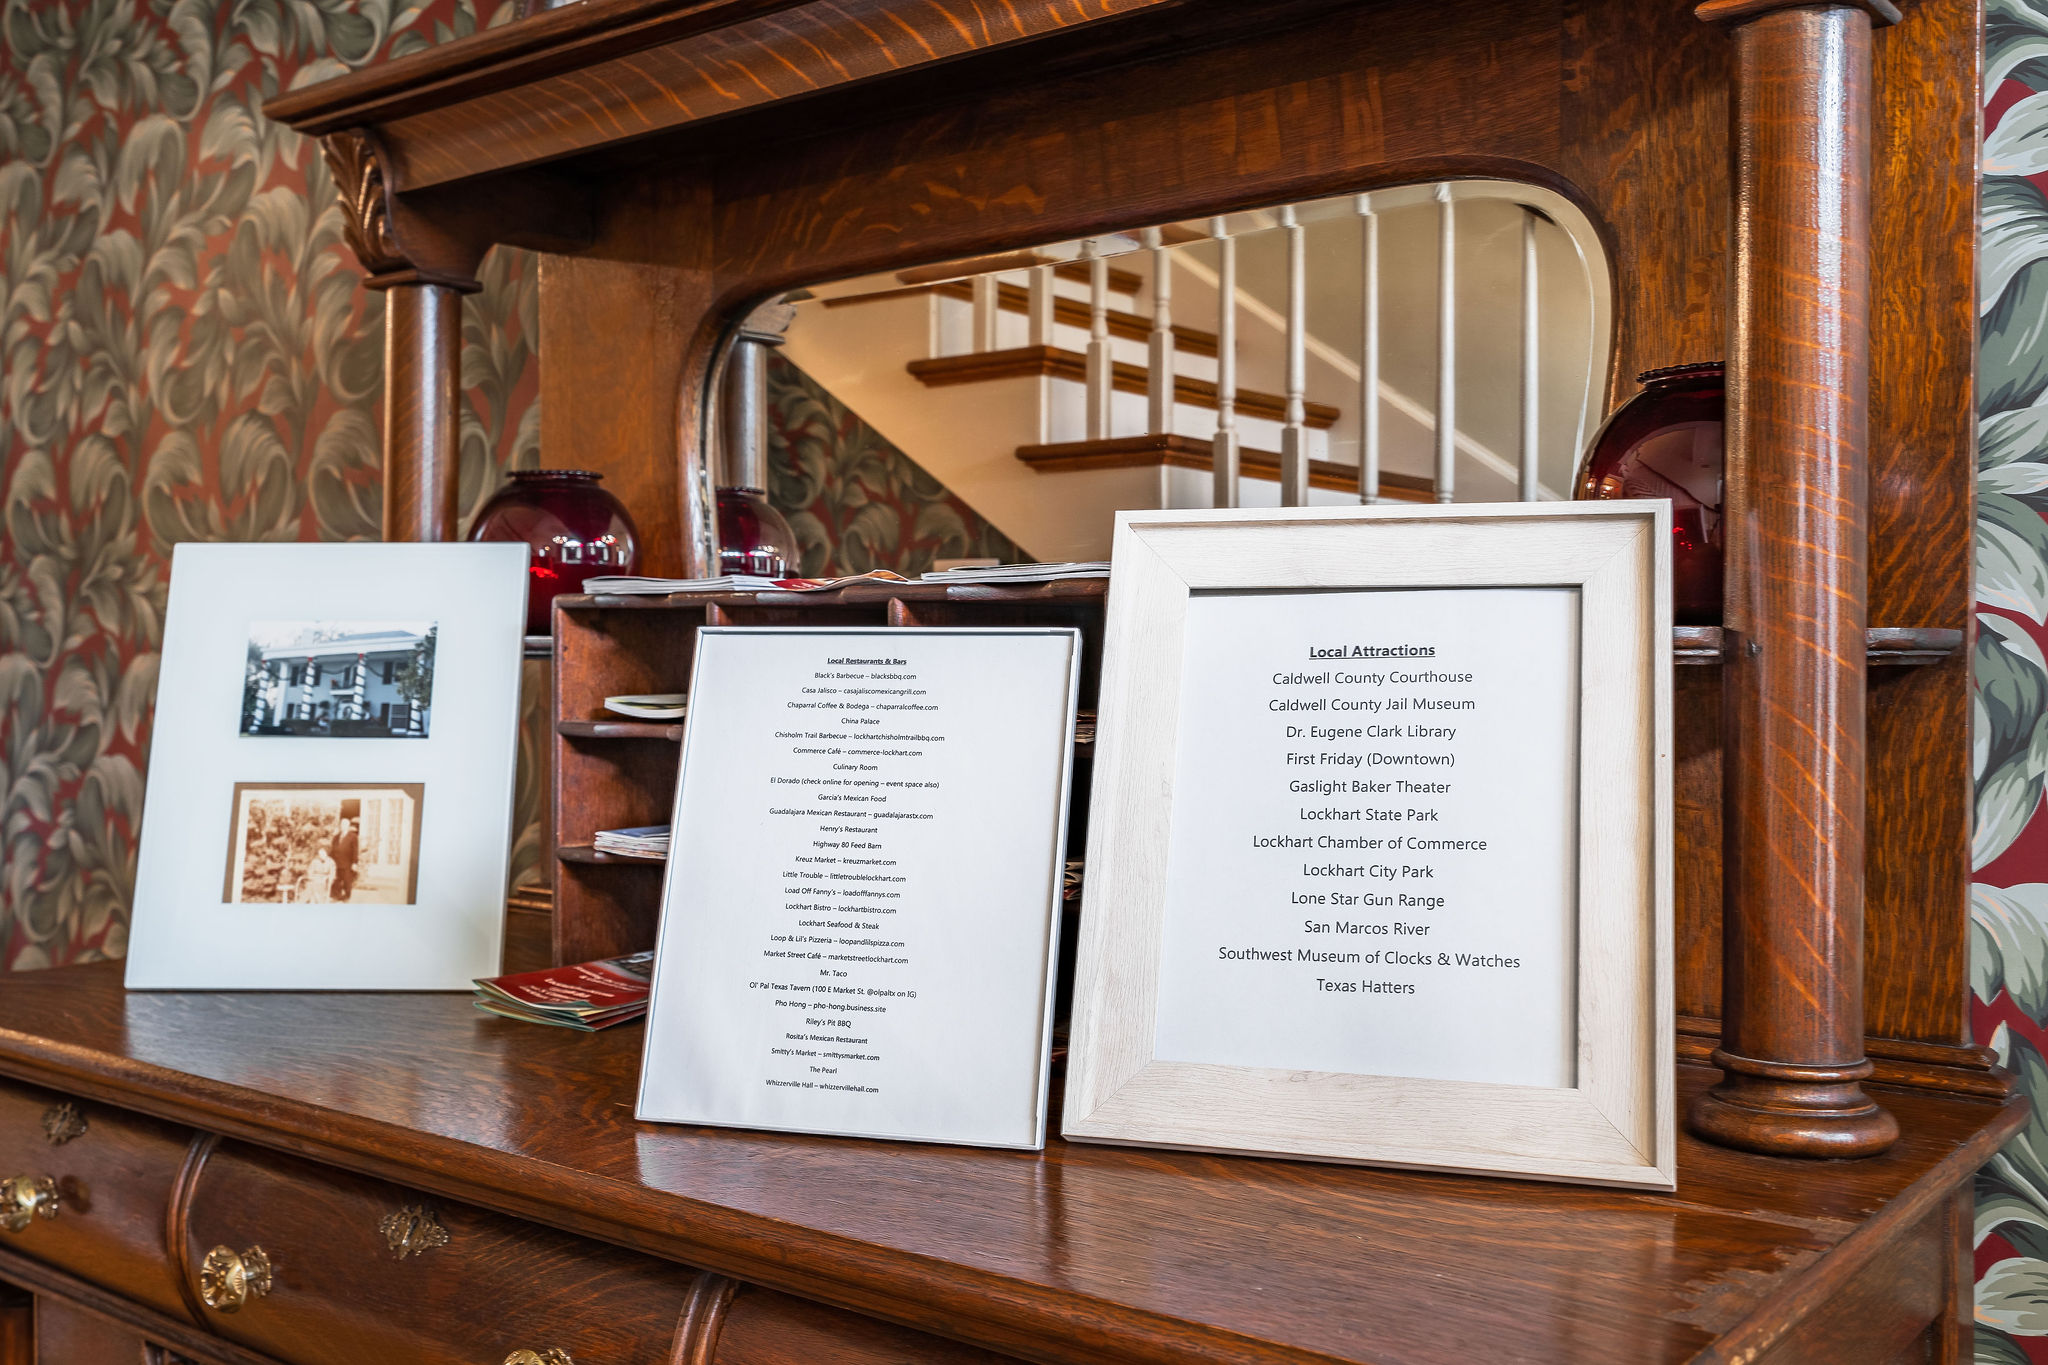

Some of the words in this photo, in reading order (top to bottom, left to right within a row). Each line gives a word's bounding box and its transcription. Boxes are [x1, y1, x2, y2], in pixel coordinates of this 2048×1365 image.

[1309, 645, 1347, 661] Local
[1351, 644, 1436, 660] Attractions
[827, 657, 845, 665] Local
[845, 657, 884, 666] Restaurants
[884, 658, 892, 666] &
[892, 658, 907, 666] Bars
[836, 672, 865, 680] Barbecue
[870, 672, 917, 681] blacksbbq.com
[1272, 671, 1330, 685] Caldwell
[1334, 672, 1386, 687] County
[1389, 670, 1473, 684] Courthouse
[801, 686, 817, 694] Casa
[843, 687, 927, 697] casajaliscomexicangrill.com
[786, 701, 817, 710] Chaparral
[817, 701, 838, 709] Coffee
[845, 702, 870, 711] Bodega
[875, 703, 939, 711] chaparralcoffee.com
[1268, 698, 1327, 712] Caldwell
[1331, 698, 1382, 714] County
[1385, 697, 1408, 711] Jail
[1413, 697, 1475, 710] Museum
[840, 717, 859, 725] China
[860, 717, 881, 725] Palace
[774, 731, 804, 739] Chisholm
[818, 732, 848, 740] Barbecue
[853, 733, 945, 743] lockhartchisholmtrailbbq.com
[1286, 725, 1306, 738] Dr.
[1310, 725, 1363, 741] Eugene
[1366, 724, 1403, 738] Clark
[1407, 724, 1457, 741] Library
[792, 746, 827, 755] Commerce
[827, 747, 842, 755] Café
[847, 749, 923, 757] commerce-lockhart.com
[1287, 752, 1316, 765] First
[1320, 752, 1363, 769] Friday
[1367, 752, 1455, 768] (Downtown)
[832, 763, 859, 772] Culinary
[859, 763, 878, 771] Room
[770, 776, 776, 784] El
[777, 777, 801, 785] Dorado
[801, 777, 822, 785] (check
[822, 778, 842, 786] online
[843, 778, 853, 786] for
[853, 779, 880, 789] opening
[924, 781, 940, 789] also)
[1289, 779, 1348, 796] Gaslight
[1352, 779, 1392, 793] Baker
[1395, 780, 1452, 794] Theater
[817, 793, 842, 801] Garcia's
[843, 794, 869, 802] Mexican
[870, 795, 887, 803] Food
[768, 807, 806, 817] Guadalajara
[806, 809, 833, 817] Mexican
[833, 809, 867, 818] Restaurant
[873, 811, 934, 821] guadalajarastx.com
[1300, 807, 1361, 821] Lockhart
[1365, 808, 1402, 821] State
[1407, 808, 1439, 822] Park
[819, 825, 844, 834] Henry's
[844, 825, 878, 834] Restaurant
[812, 840, 841, 850] Highway
[840, 841, 850, 849] 80
[850, 841, 867, 849] Feed
[867, 842, 882, 850] Barn
[1253, 834, 1314, 848] Lockhart
[1317, 835, 1384, 849] Chamber
[1387, 836, 1403, 850] of
[1406, 837, 1487, 851] Commerce
[795, 855, 813, 863] Kreuz
[814, 856, 837, 864] Market
[842, 857, 897, 866] kreuzmarket.com
[782, 870, 799, 879] Little
[799, 871, 824, 879] Trouble
[829, 872, 907, 883] littletroublelockhart.com
[1303, 863, 1365, 877] Lockhart
[1369, 864, 1398, 881] City
[1402, 865, 1434, 878] Park
[801, 887, 813, 895] Off
[812, 887, 837, 897] Fanny's
[1291, 891, 1326, 905] Lone
[1330, 892, 1360, 906] Star
[1363, 893, 1393, 906] Gun
[1398, 893, 1445, 911] Range
[785, 903, 813, 911] Lockhart
[813, 903, 832, 912] Bistro
[837, 905, 897, 915] lockhartbistro.com
[798, 919, 826, 928] Lockhart
[826, 920, 854, 929] Seafood
[853, 921, 861, 929] &
[861, 922, 880, 930] Steak
[1304, 920, 1330, 934] San
[1335, 921, 1389, 935] Marcos
[1394, 922, 1430, 936] River
[770, 934, 787, 943] Loop
[787, 934, 795, 942] &
[795, 935, 807, 943] Lil's
[808, 935, 833, 944] Pizzeria
[763, 950, 786, 958] Market
[786, 950, 806, 959] Street
[806, 952, 822, 960] Café
[827, 953, 909, 964] marketstreetlockhart.com
[1218, 946, 1293, 961] Southwest
[1297, 948, 1360, 963] Museum
[1365, 950, 1381, 964] of
[1384, 950, 1432, 966] Clocks
[1437, 952, 1451, 966] &
[1455, 953, 1521, 968] Watches
[819, 969, 831, 977] Mr.
[832, 969, 848, 978] Taco
[759, 982, 770, 990] Pal
[770, 982, 789, 991] Texas
[789, 983, 811, 992] Tavern
[811, 985, 827, 993] (100
[827, 985, 832, 993] E
[832, 986, 856, 995] Market
[857, 987, 865, 995] St.
[906, 990, 917, 999] IG)
[1316, 978, 1357, 993] Texas
[1362, 979, 1415, 995] Hatters
[774, 999, 788, 1007] Pho
[788, 1000, 807, 1010] Hong
[812, 1002, 887, 1013] pho-hong.business.site
[805, 1017, 826, 1027] Riley's
[827, 1019, 836, 1027] Pit
[837, 1019, 852, 1029] BBQ
[785, 1032, 809, 1041] Rosita's
[809, 1034, 835, 1042] Mexican
[835, 1035, 868, 1045] Restaurant
[771, 1047, 795, 1057] Smitty's
[795, 1049, 817, 1057] Market
[822, 1051, 880, 1061] smittysmarket.com
[809, 1065, 821, 1074] The
[821, 1066, 838, 1074] Pearl
[765, 1079, 801, 1088] Whizzerville
[801, 1081, 814, 1089] Hall
